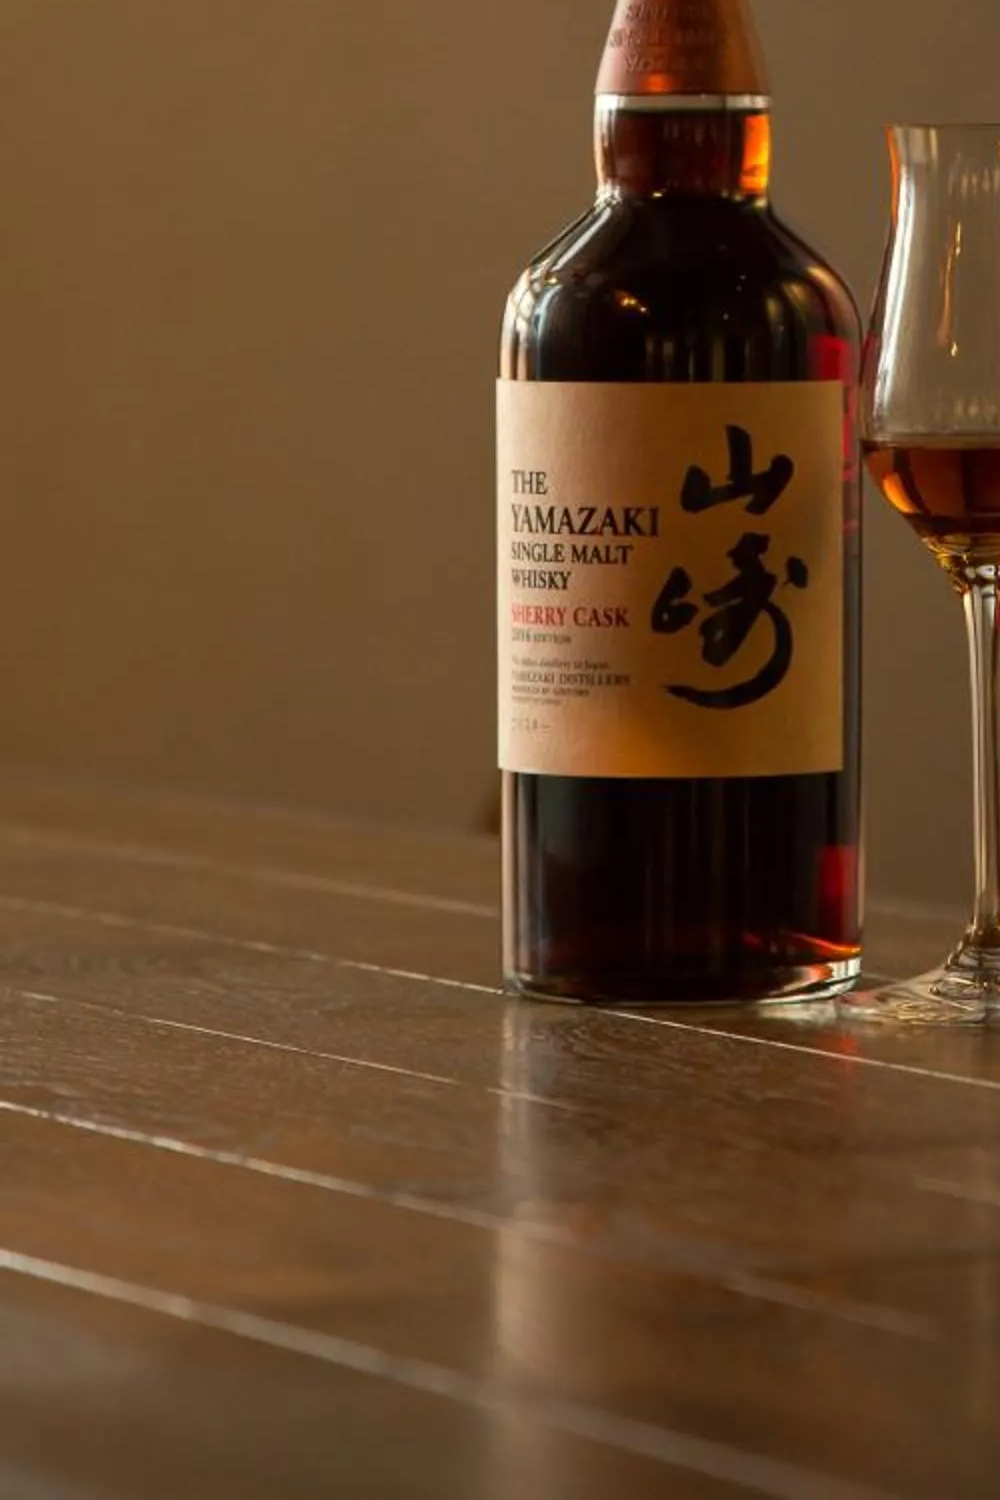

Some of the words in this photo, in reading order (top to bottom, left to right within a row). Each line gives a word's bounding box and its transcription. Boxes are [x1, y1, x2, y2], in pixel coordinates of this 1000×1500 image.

[511, 469, 548, 495] THE
[511, 503, 659, 536] YAMAZAKI
[511, 541, 565, 563] SINGLE
[571, 544, 633, 565] MALT
[511, 569, 572, 590] WHISKY
[511, 603, 567, 626] SHERRY
[573, 606, 631, 628] CASK
